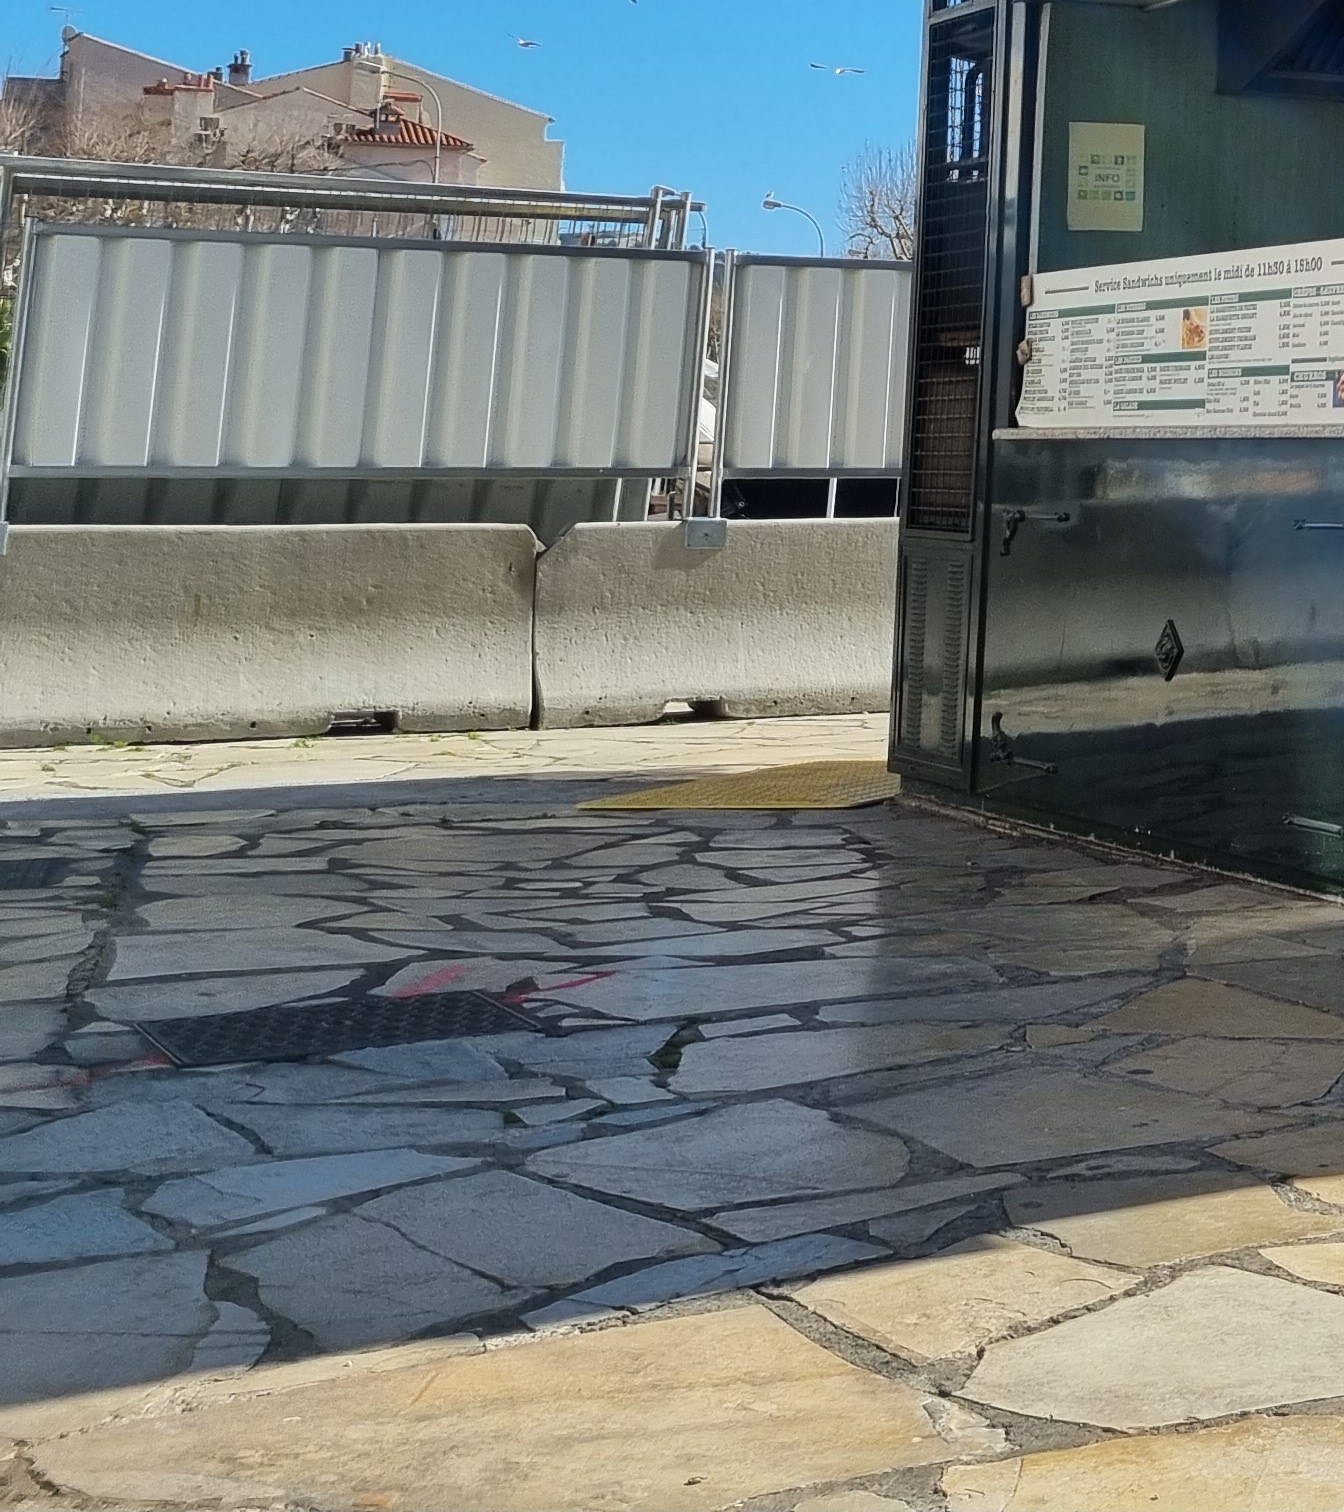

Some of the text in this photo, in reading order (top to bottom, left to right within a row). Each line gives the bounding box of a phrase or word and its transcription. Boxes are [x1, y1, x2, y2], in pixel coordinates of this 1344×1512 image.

[1095, 278, 1120, 293] Service
[1165, 268, 1212, 288] uniquement
[1214, 268, 1221, 281] le
[1223, 264, 1243, 280] midi
[1245, 264, 1254, 278] de
[1257, 261, 1284, 277] 11h30
